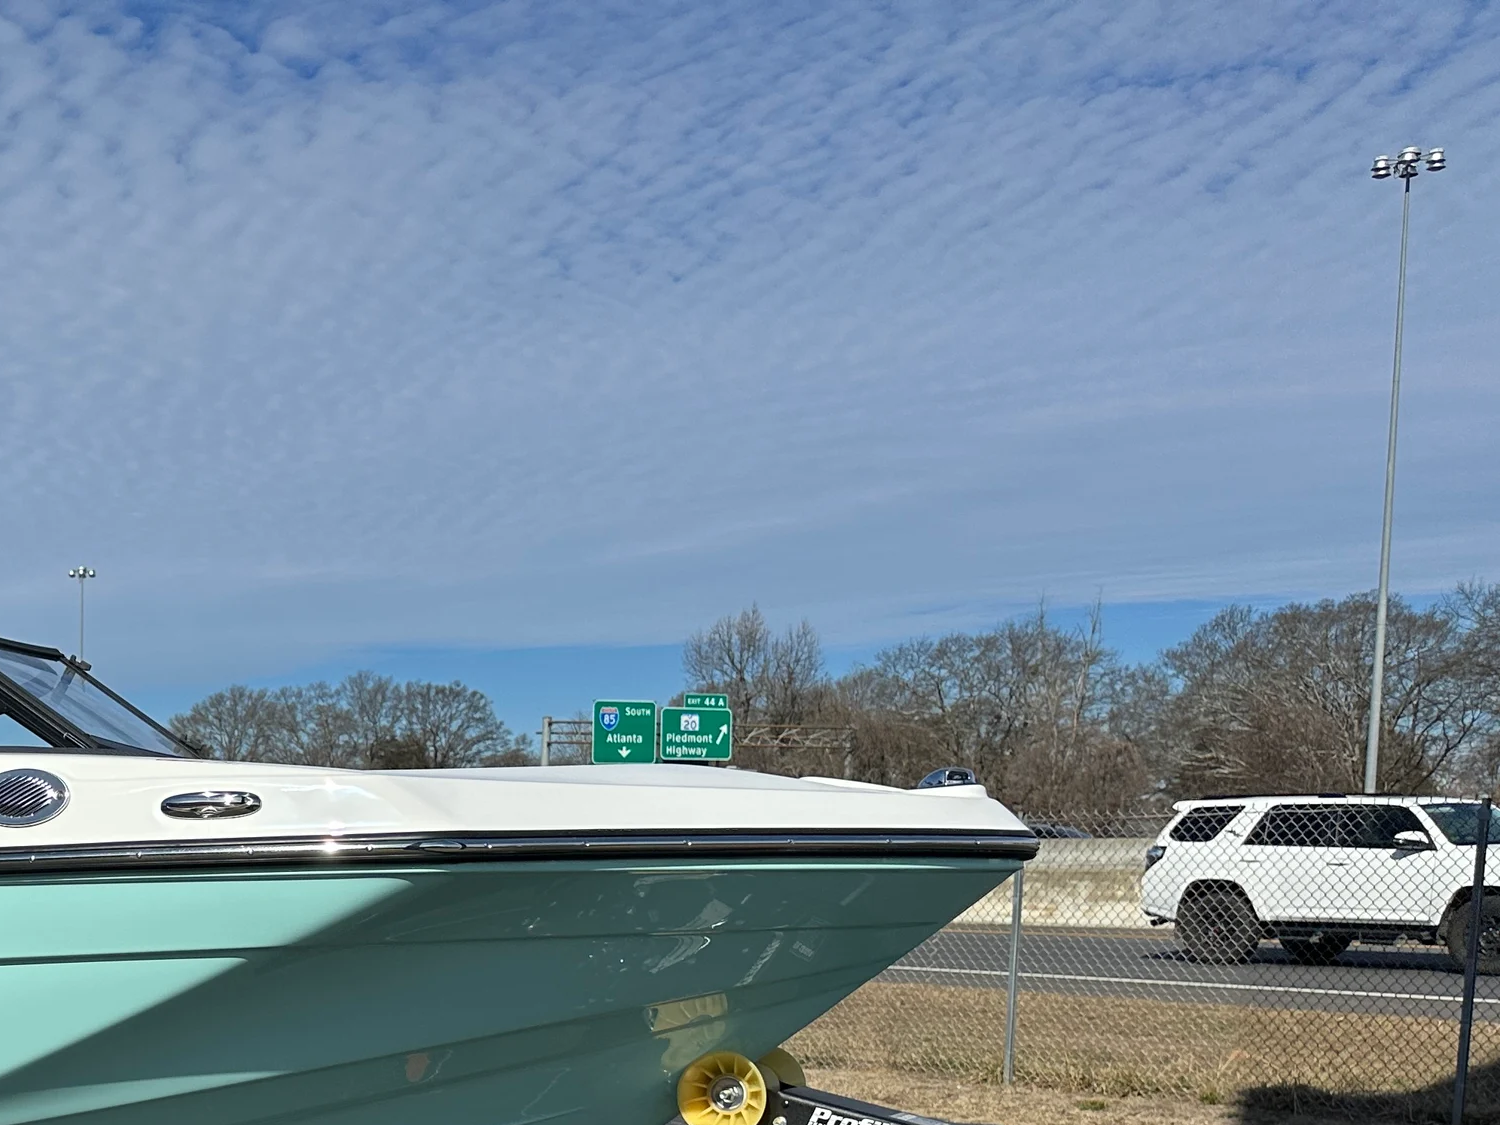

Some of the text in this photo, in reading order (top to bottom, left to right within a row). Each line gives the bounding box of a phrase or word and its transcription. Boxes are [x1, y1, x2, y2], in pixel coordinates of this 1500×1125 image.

[704, 697, 715, 706] 44
[718, 698, 725, 706] A
[603, 714, 616, 725] 85
[683, 720, 697, 730] 20
[606, 733, 643, 743] Atlanta
[666, 733, 713, 743] Piedmont
[666, 745, 708, 757] Highway
